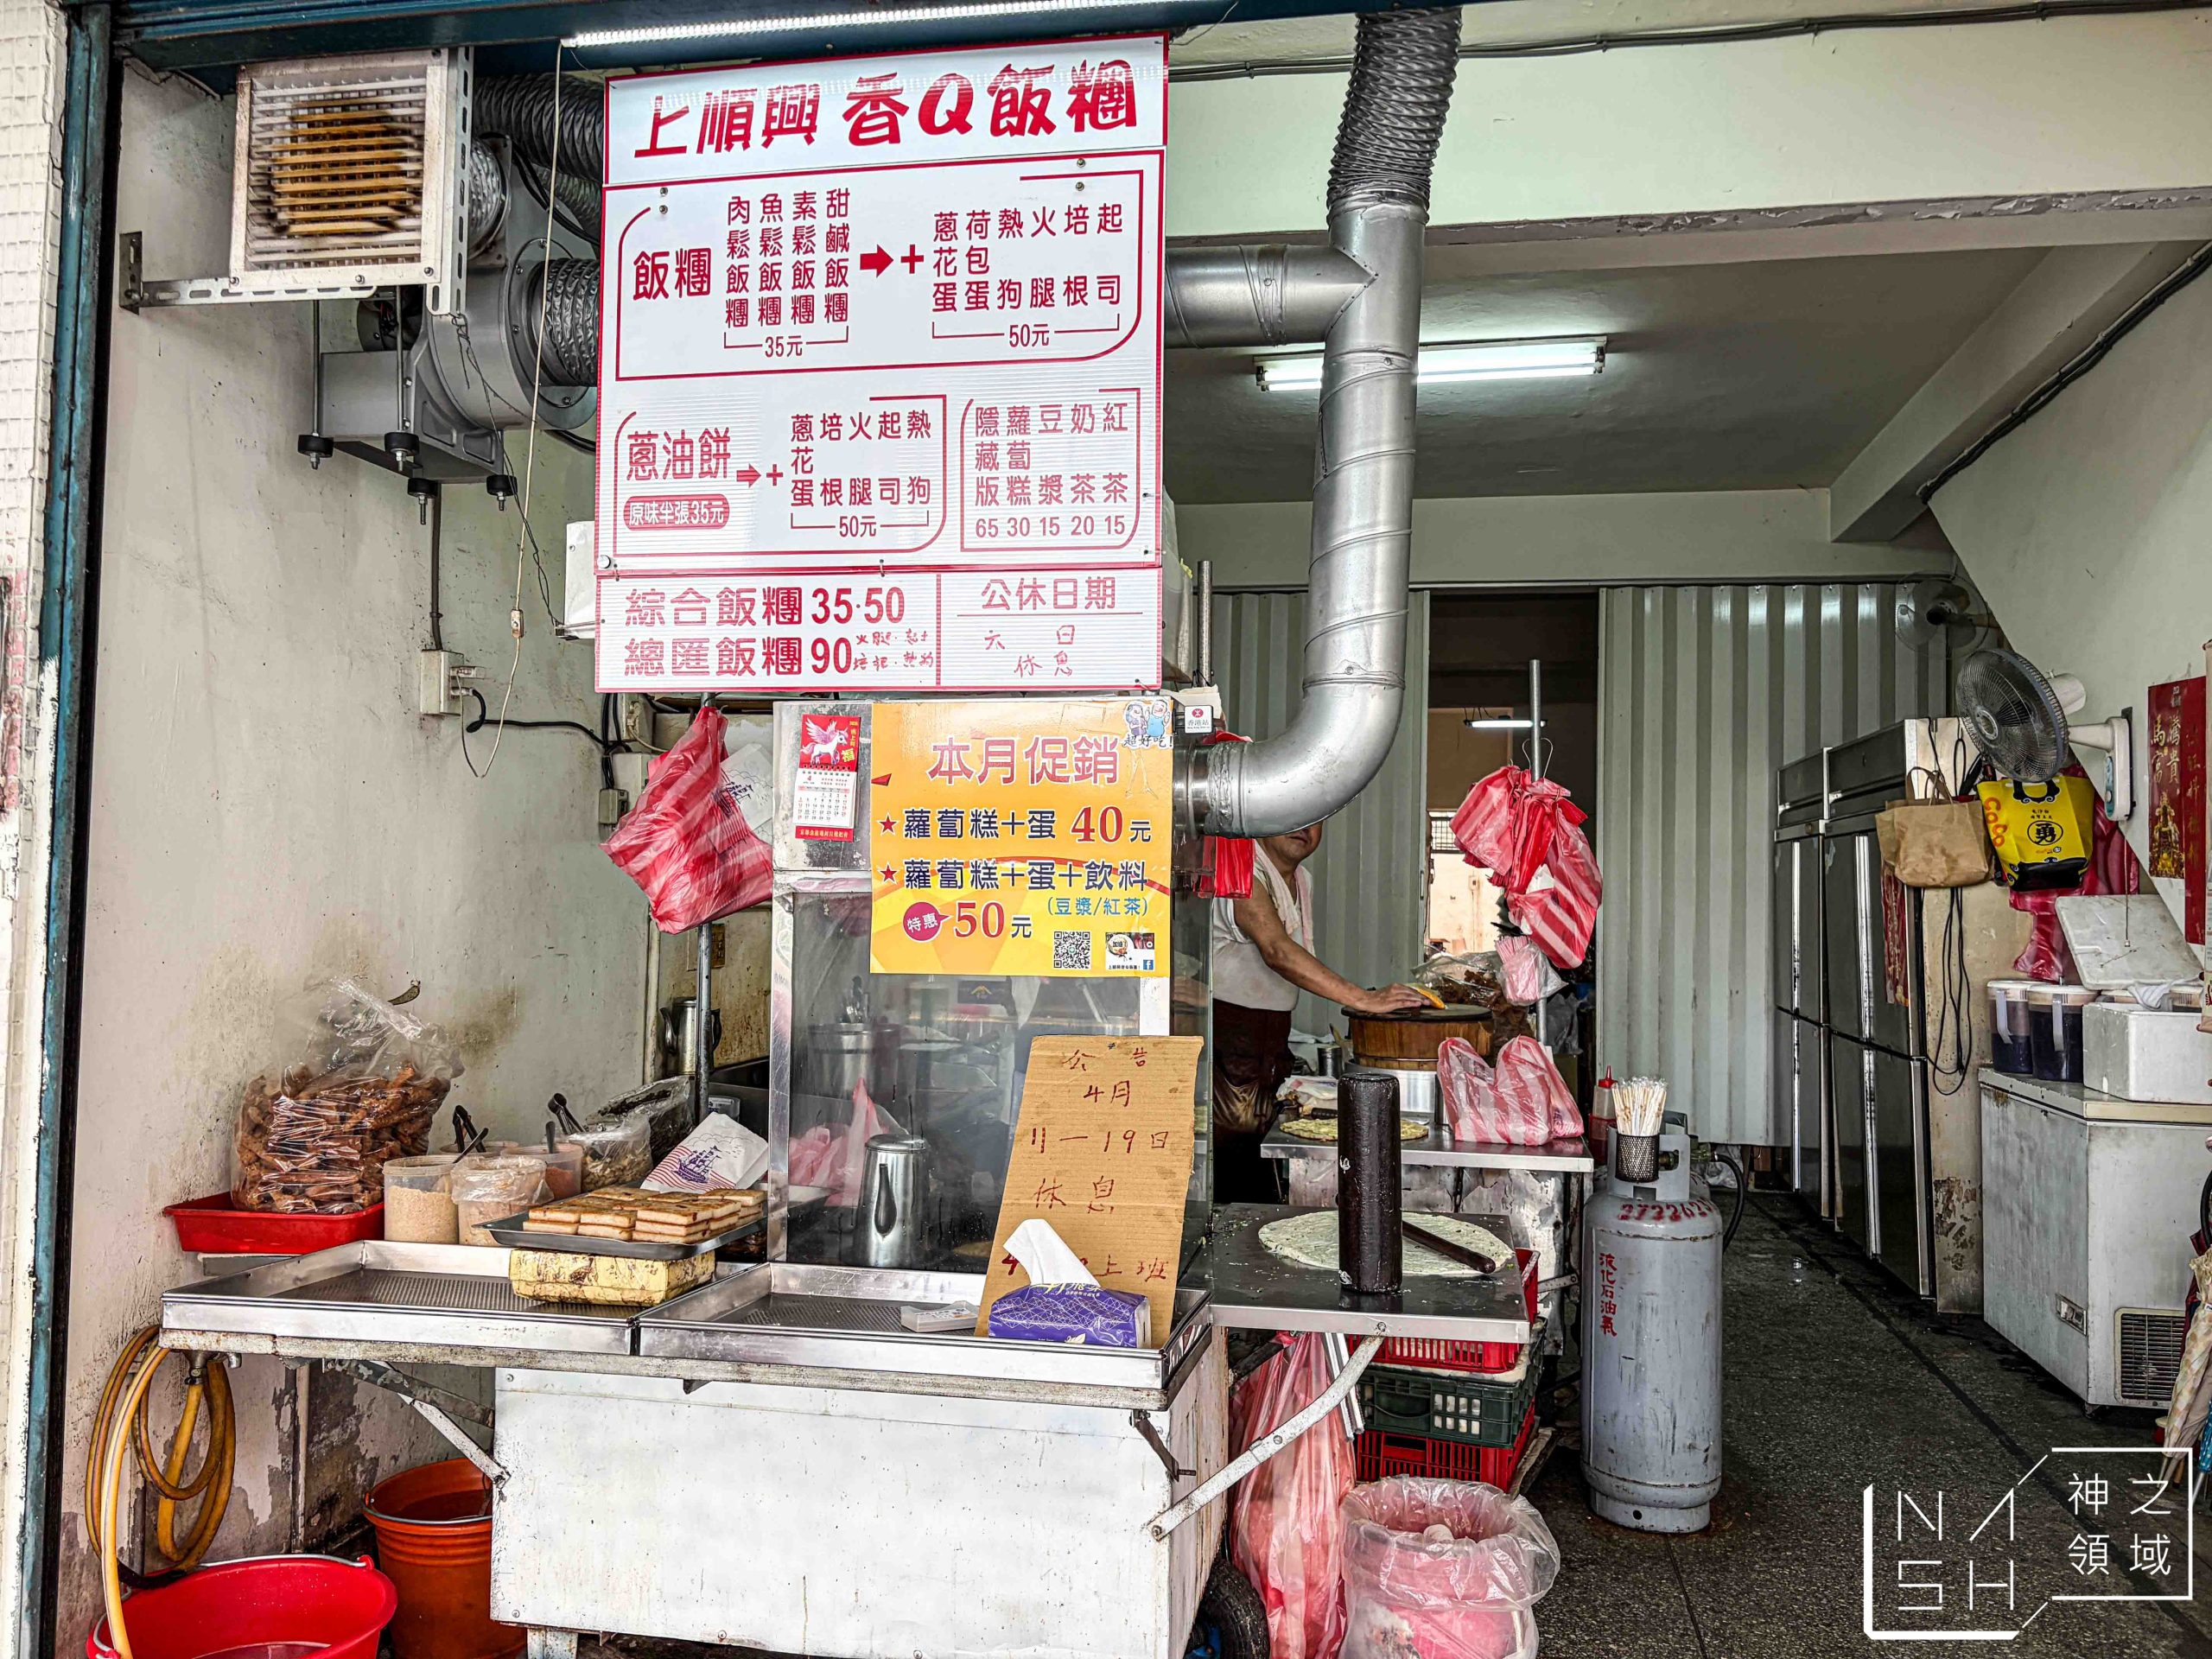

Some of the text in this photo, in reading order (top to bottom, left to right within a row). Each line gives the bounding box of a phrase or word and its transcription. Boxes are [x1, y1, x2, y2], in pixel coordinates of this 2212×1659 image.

[633, 59, 1139, 159] 上順興 香Q飯糰
[632, 247, 712, 301] 飯糰
[725, 195, 751, 329] 肉鬆飯糰
[758, 193, 784, 328] 魚鬆飯糰
[791, 190, 817, 326] 素鬆飯糰
[823, 188, 851, 324] 甜鹹飯糰
[932, 211, 959, 314] 蔥花蛋
[965, 210, 992, 312] 荷包蛋
[997, 208, 1024, 310] 熱狗
[1029, 207, 1057, 309] 火腿
[1063, 205, 1090, 308] 培根
[1096, 202, 1124, 305] 起司
[764, 335, 804, 358] 35元
[1007, 323, 1051, 348] 50元
[626, 427, 732, 482] 蔥油餅
[790, 412, 815, 508] 蔥花蛋
[818, 411, 844, 507] 培根
[848, 411, 874, 505] 火腿
[877, 410, 903, 505] 起司
[906, 410, 932, 505] 熱狗
[975, 406, 1000, 506] 隱藏版
[1006, 405, 1032, 505] 蘿蔔糕
[1038, 404, 1064, 505] 豆漿
[1070, 403, 1096, 505] 奶茶
[1103, 402, 1128, 504] 紅茶
[838, 515, 878, 539] 50元
[976, 515, 1126, 537] 65 30 15 20 15
[624, 587, 802, 627] 綜合飯糰
[982, 576, 1116, 610] 公休日期
[624, 636, 852, 677] 總匯飯糰 90
[1014, 651, 1073, 677] 休息
[928, 736, 1119, 785] 本月促銷
[904, 809, 1057, 840] 蘿蔔糕+蛋
[2035, 823, 2056, 844] 勇
[904, 860, 1148, 893] 蘿蔔糕+蛋+飲料
[906, 912, 938, 933] 特惠
[1062, 1047, 1148, 1071] 公告
[1084, 1080, 1131, 1108] 4月
[1033, 1174, 1116, 1215] 休息
[1599, 1252, 1618, 1338] 液化石油氣
